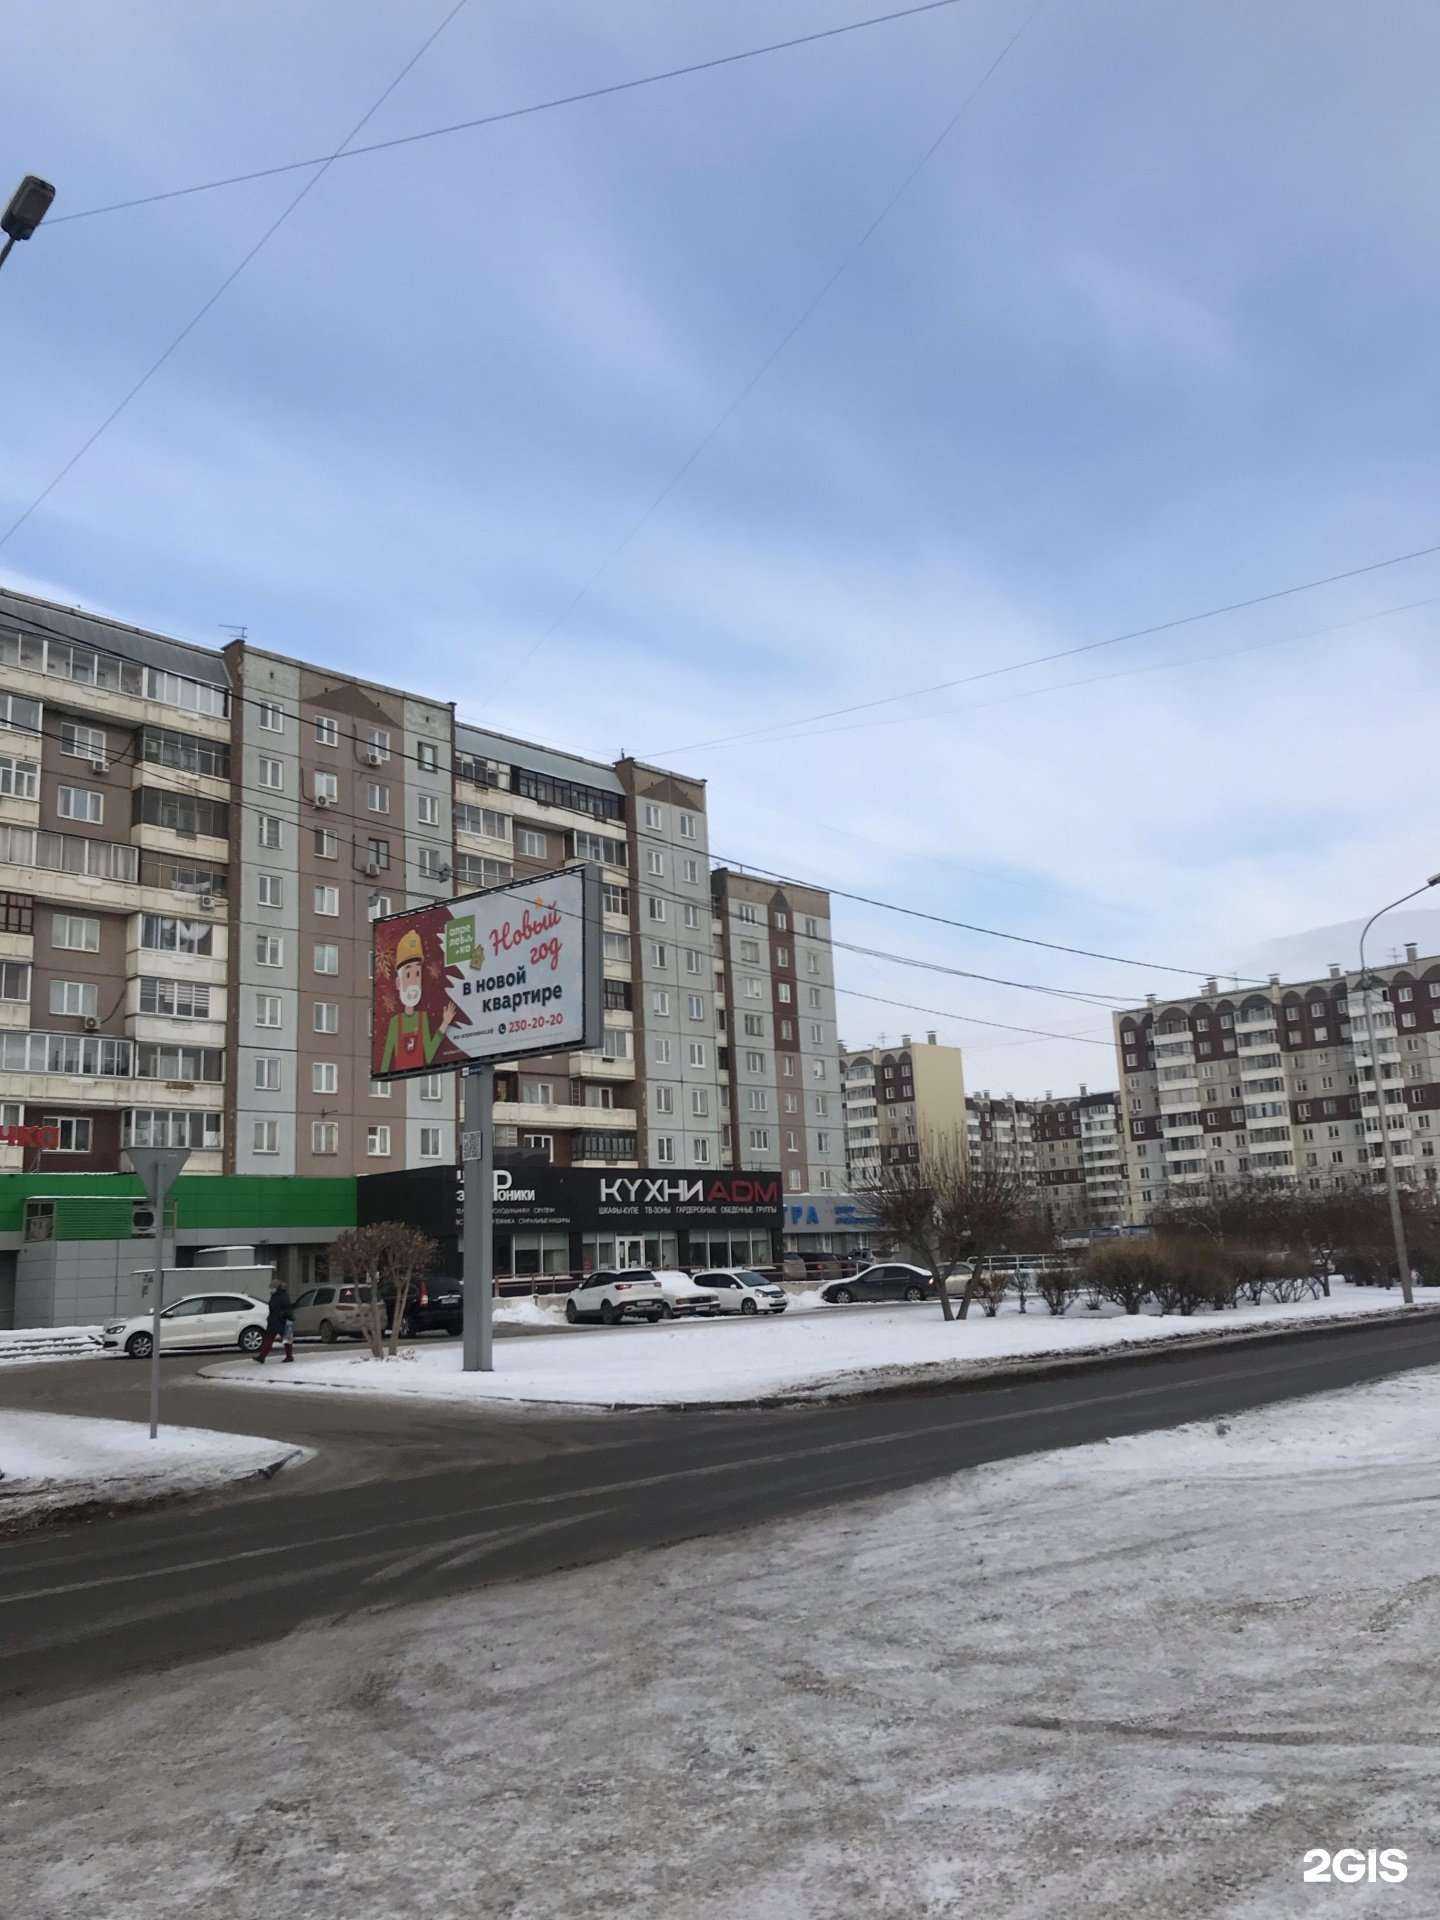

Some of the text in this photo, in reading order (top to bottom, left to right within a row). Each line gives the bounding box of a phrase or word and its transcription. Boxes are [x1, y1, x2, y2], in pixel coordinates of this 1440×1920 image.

[488, 900, 562, 956] Новый
[529, 937, 563, 971] год
[476, 965, 527, 993] новой
[482, 984, 562, 1013] квартире
[508, 1012, 564, 1034] 230-20-20
[600, 1178, 777, 1202] КУХНИ ADM
[675, 1206, 717, 1214] ГАРДЕРОБНЫЕ
